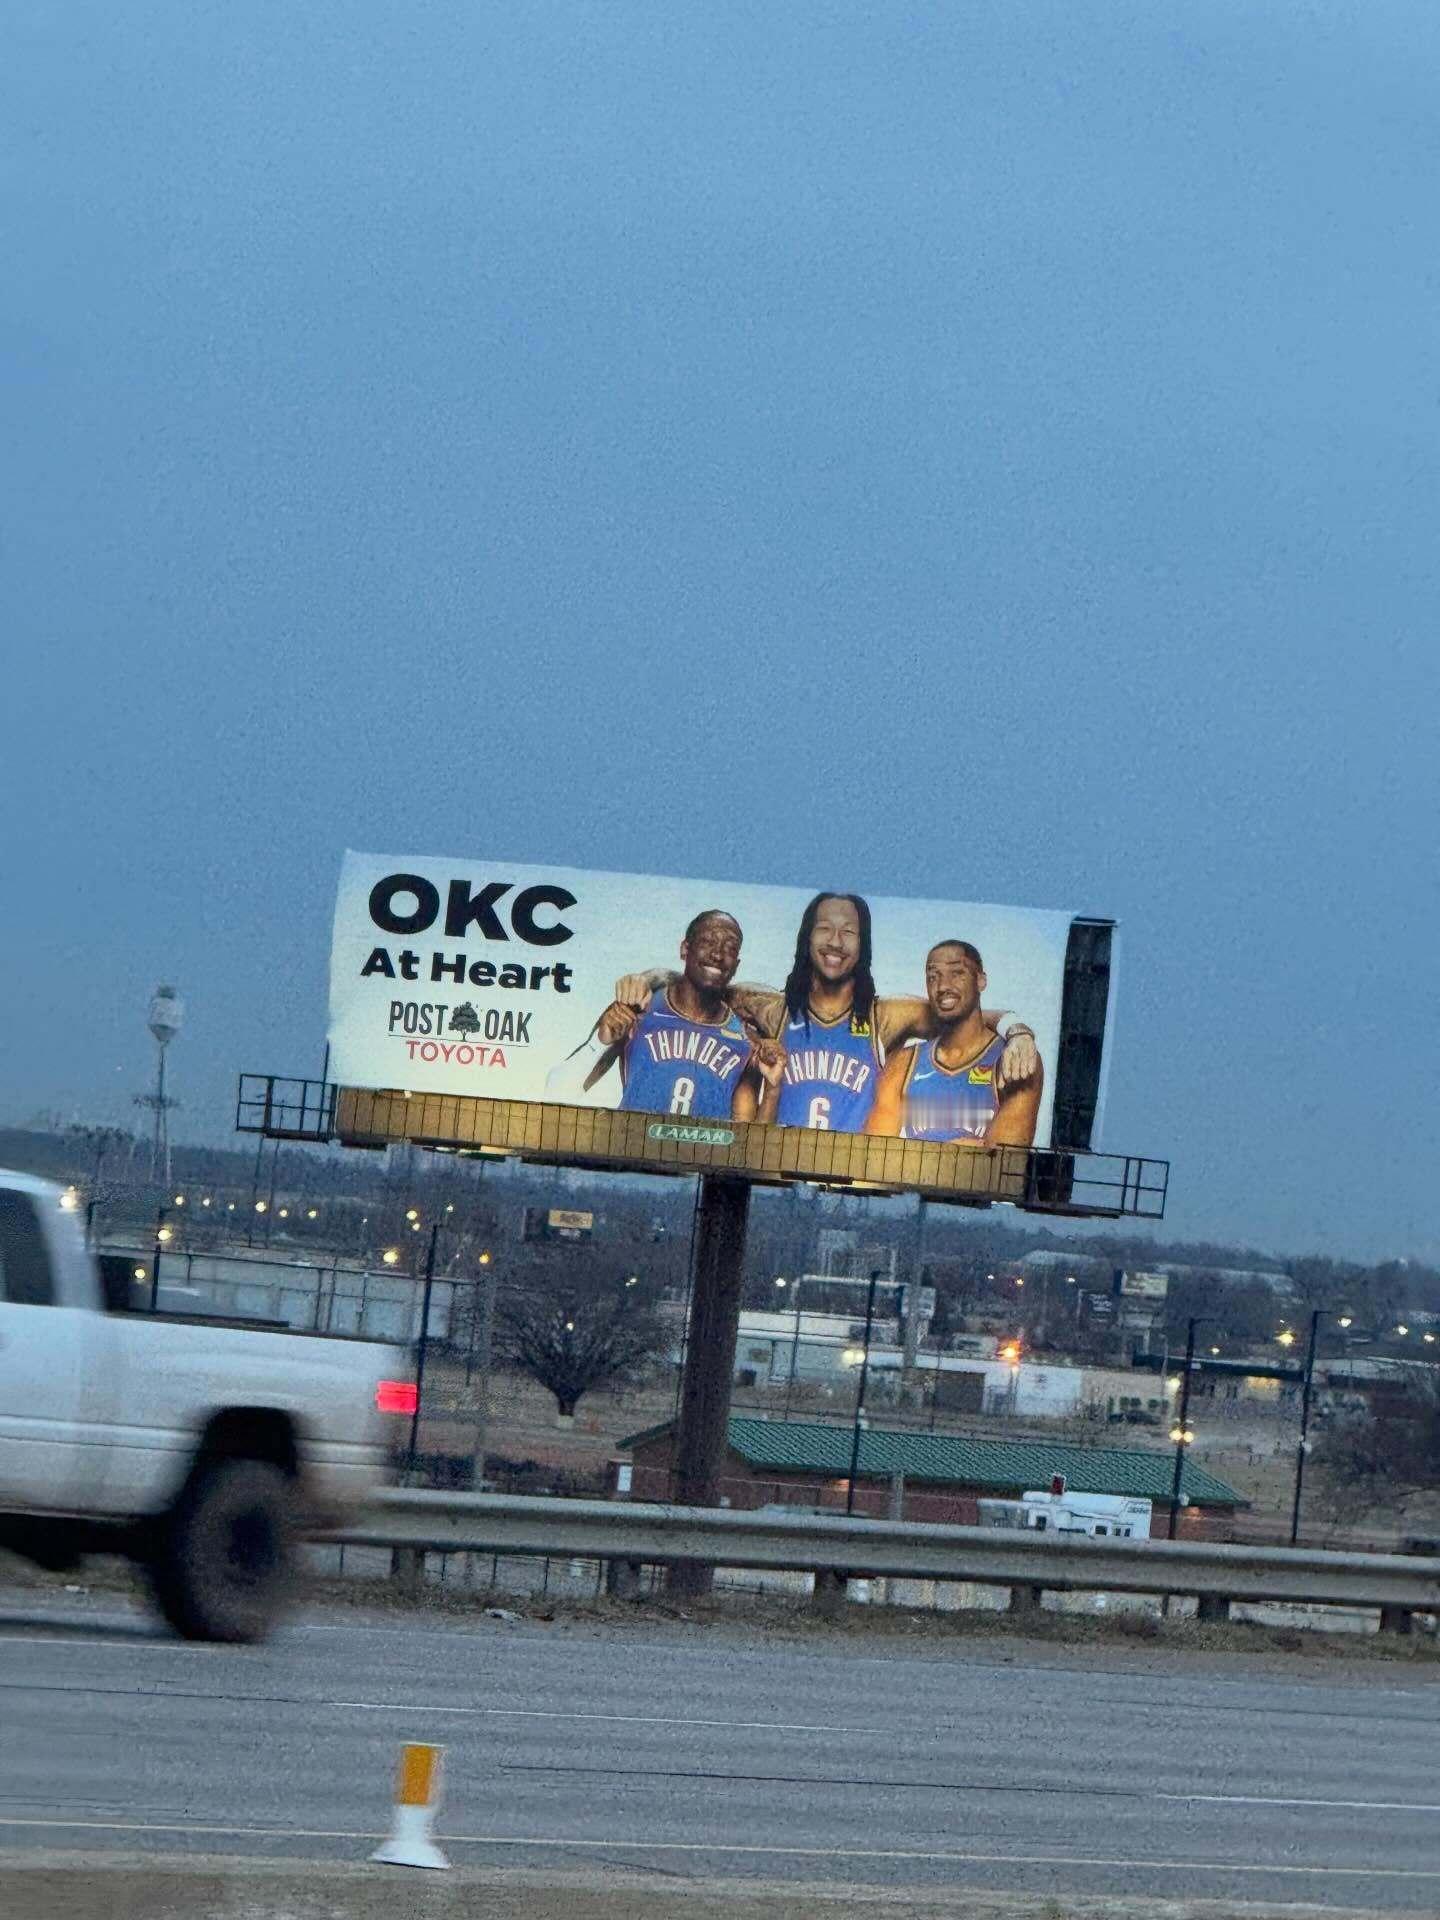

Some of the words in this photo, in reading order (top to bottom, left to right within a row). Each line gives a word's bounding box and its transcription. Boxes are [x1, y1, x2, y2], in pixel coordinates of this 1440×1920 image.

[369, 873, 577, 946] OKC
[360, 947, 420, 980] At
[431, 952, 573, 993] Heart
[389, 1000, 448, 1035] POST
[485, 1009, 533, 1043] OAK
[406, 1041, 507, 1067] TOYOTA
[645, 1031, 740, 1080] THUNDER
[670, 1077, 696, 1116] 8
[809, 1097, 831, 1129] 6
